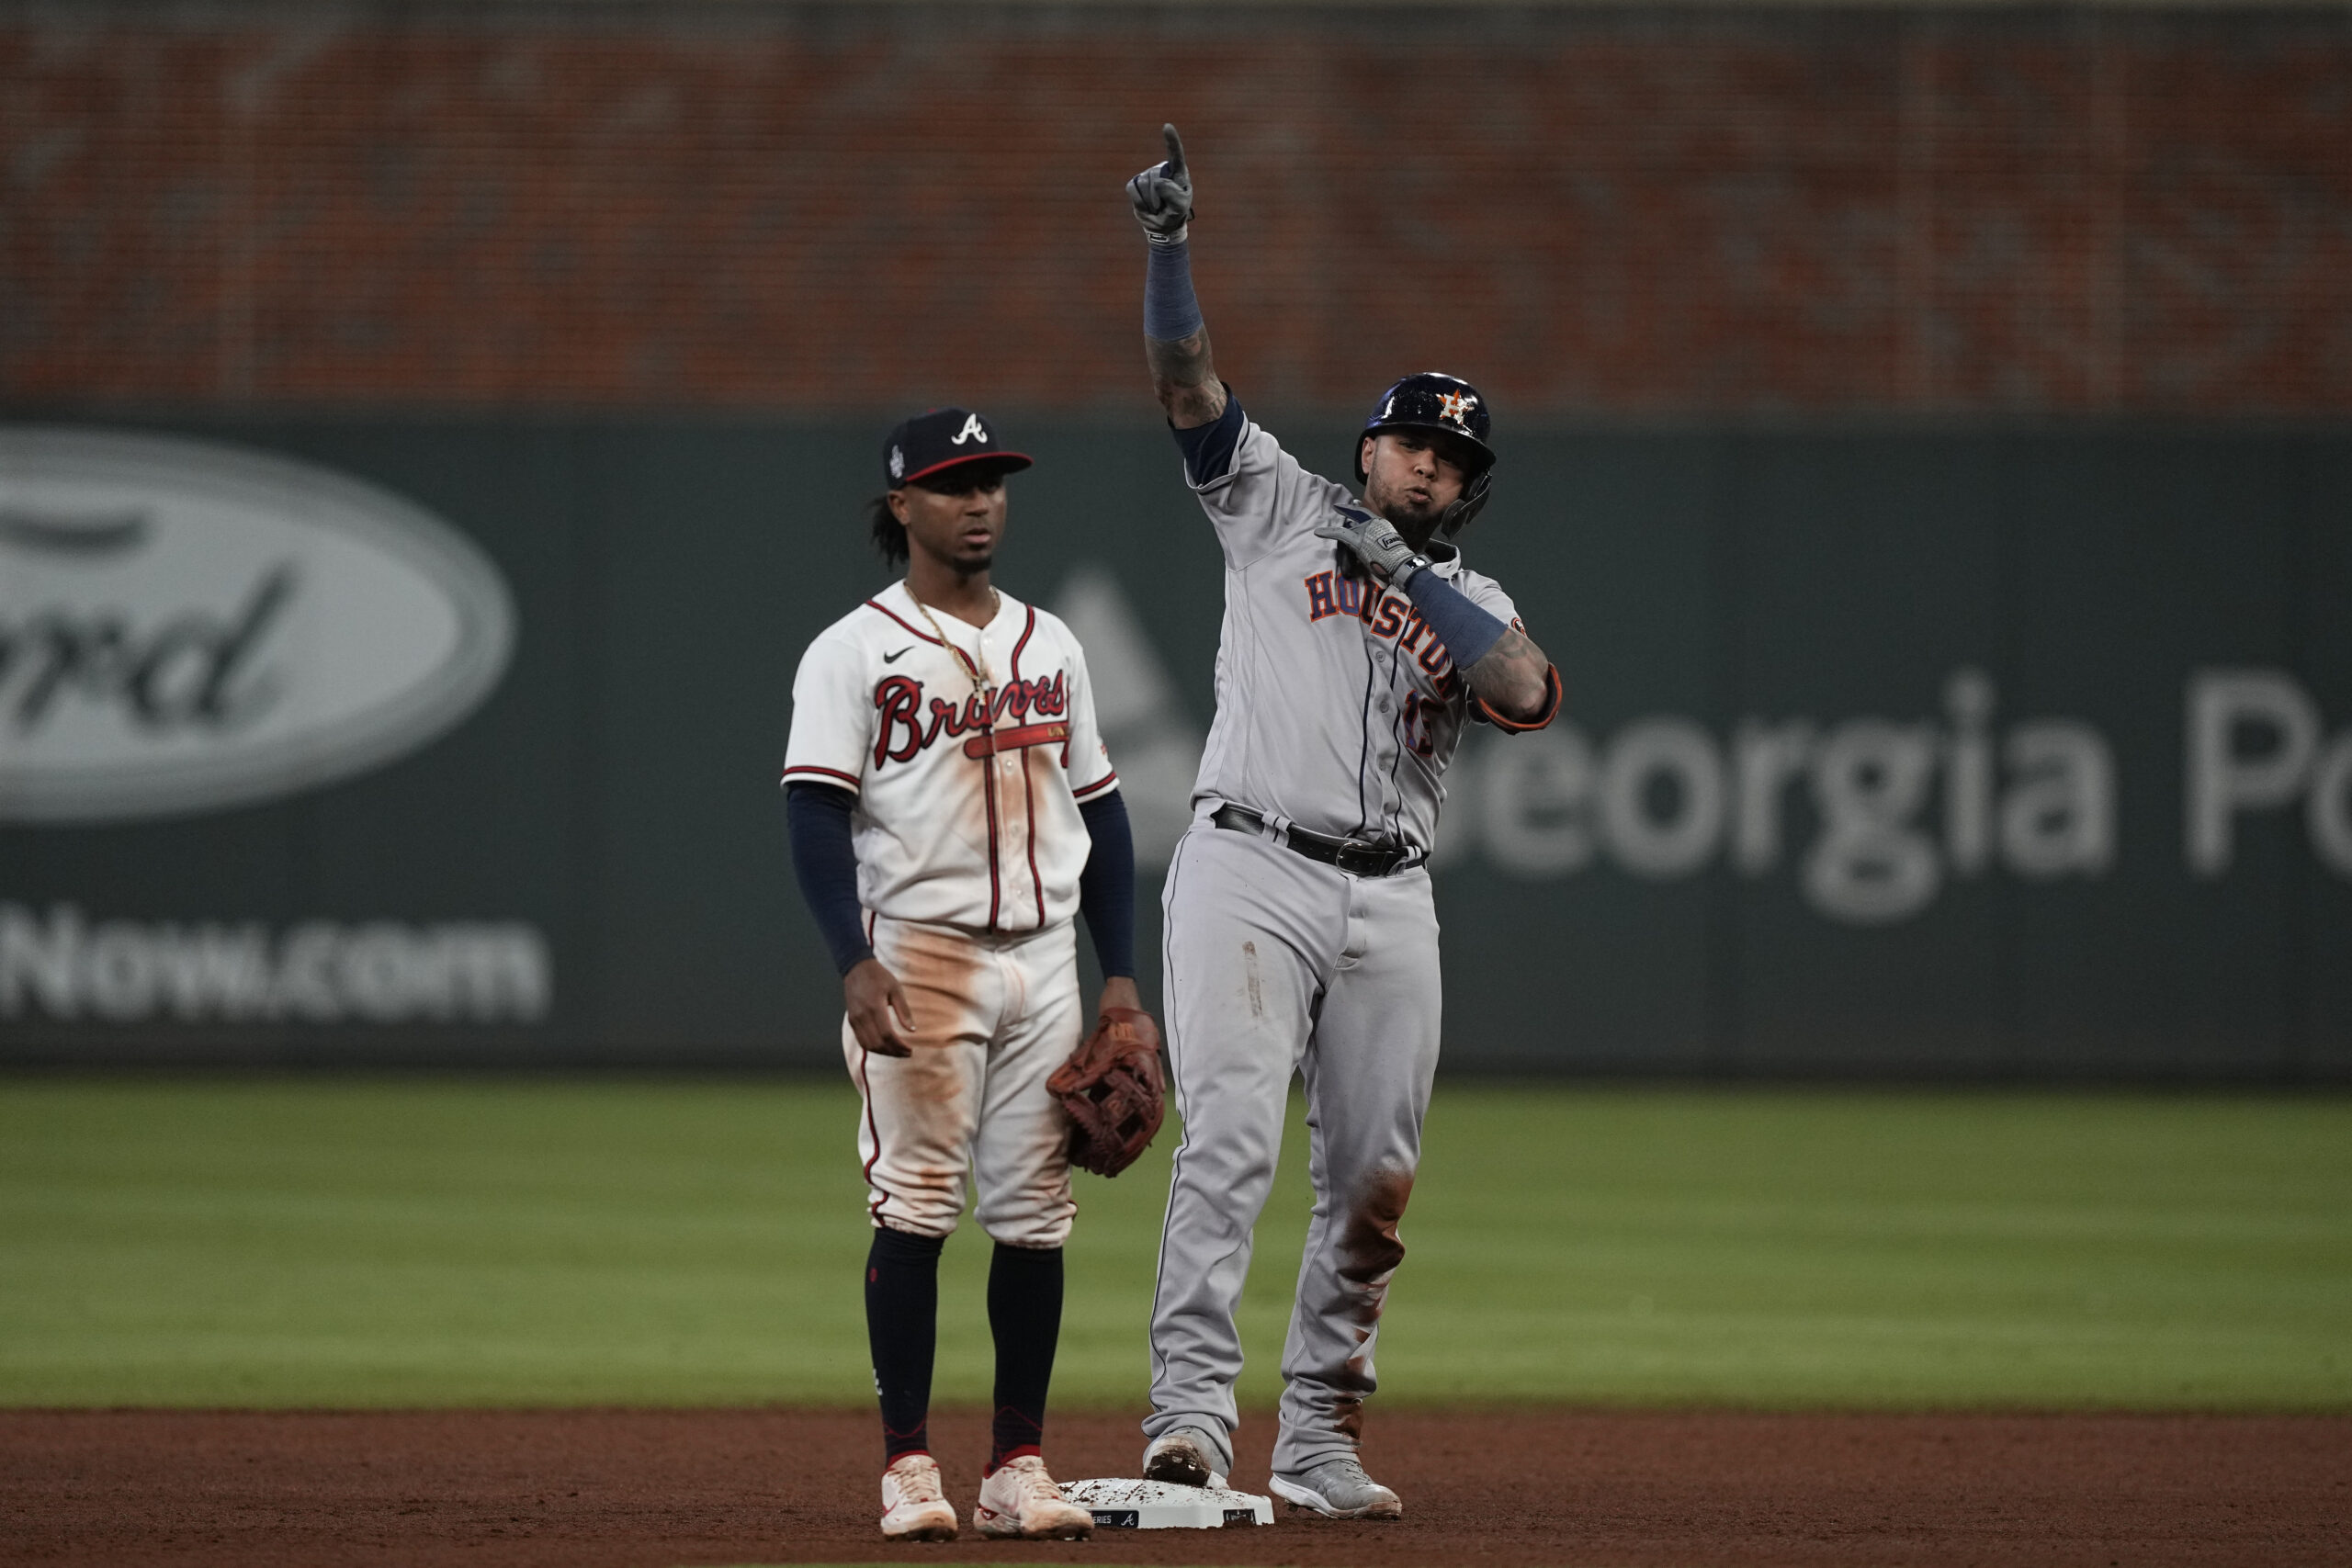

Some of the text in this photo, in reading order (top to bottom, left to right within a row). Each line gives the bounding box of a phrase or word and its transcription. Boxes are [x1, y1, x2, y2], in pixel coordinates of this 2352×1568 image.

[951, 413, 988, 445] A
[874, 670, 1066, 771] Braves
[1435, 669, 2115, 920] eorgia
[1092, 1515, 1112, 1524] ERIES
